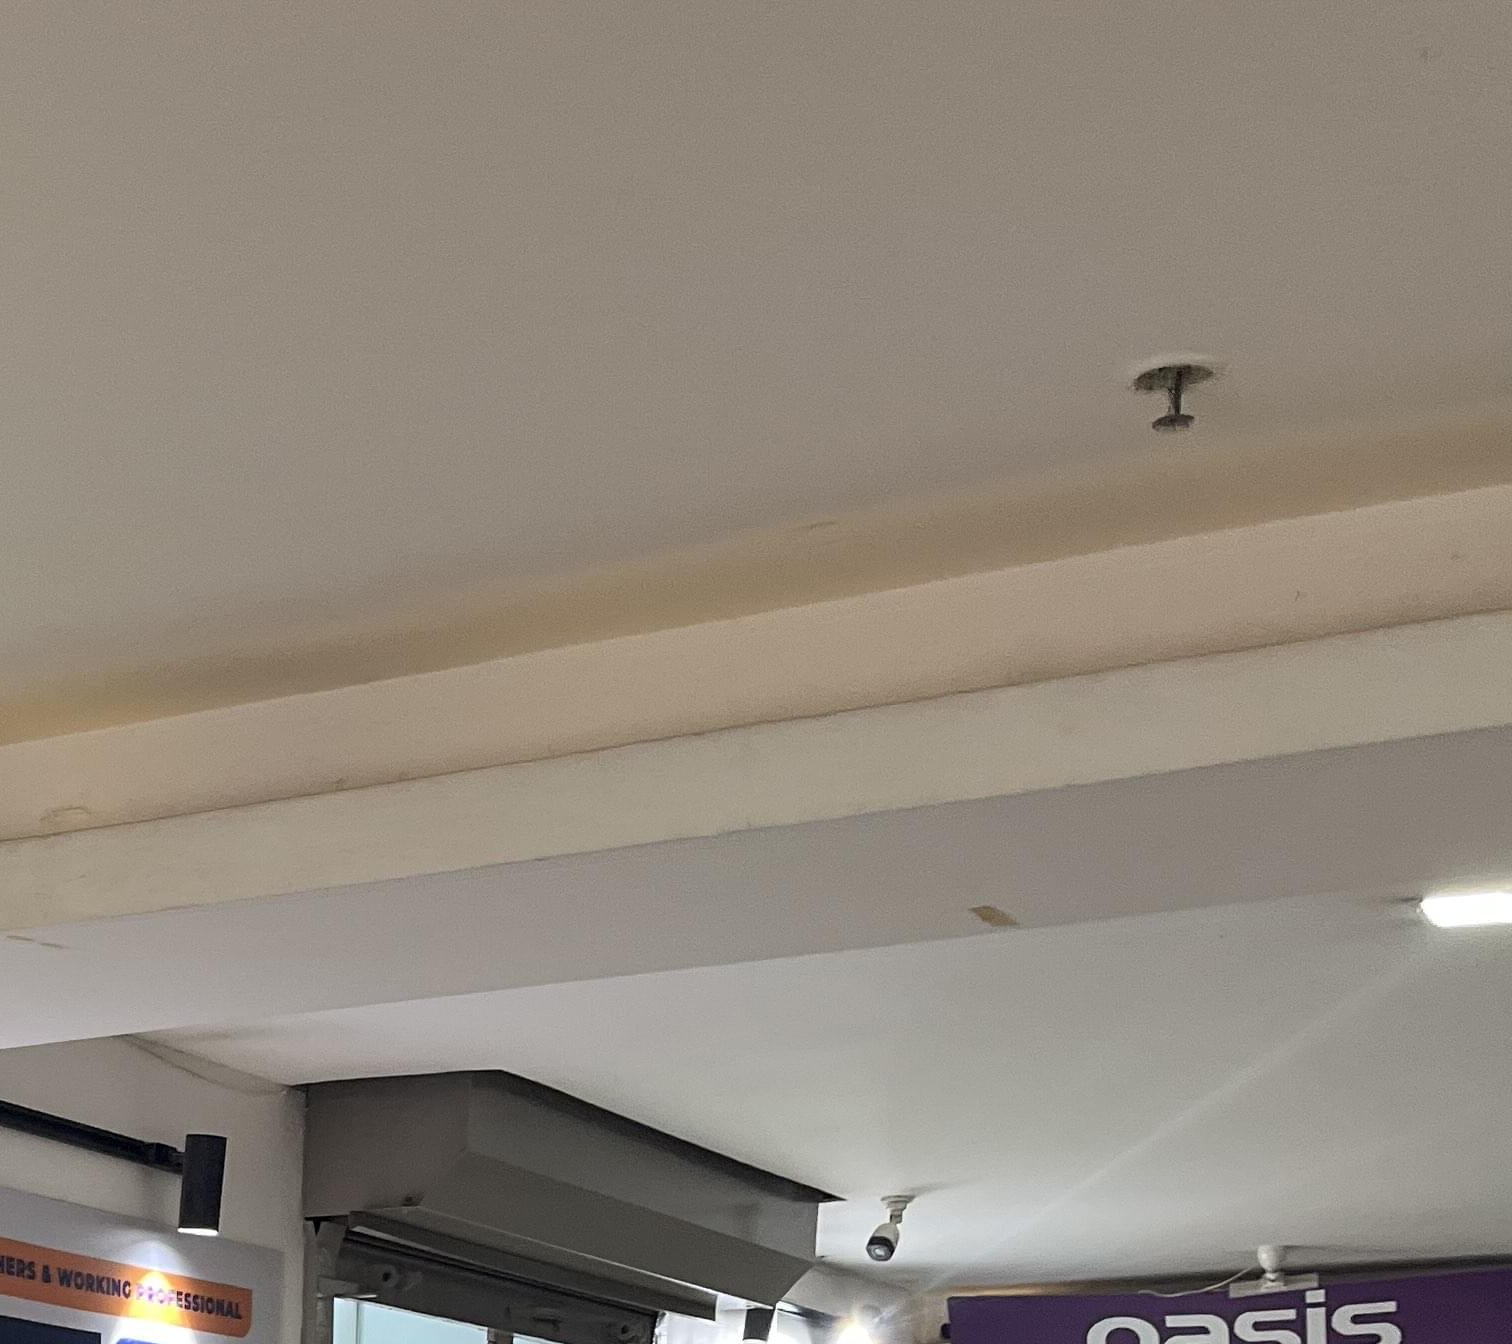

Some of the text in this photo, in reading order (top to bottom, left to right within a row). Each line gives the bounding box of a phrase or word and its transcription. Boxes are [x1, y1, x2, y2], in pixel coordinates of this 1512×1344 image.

[42, 1268, 51, 1284] &
[57, 1267, 132, 1300] WORKING
[136, 1283, 242, 1320] PROFESSIONAL
